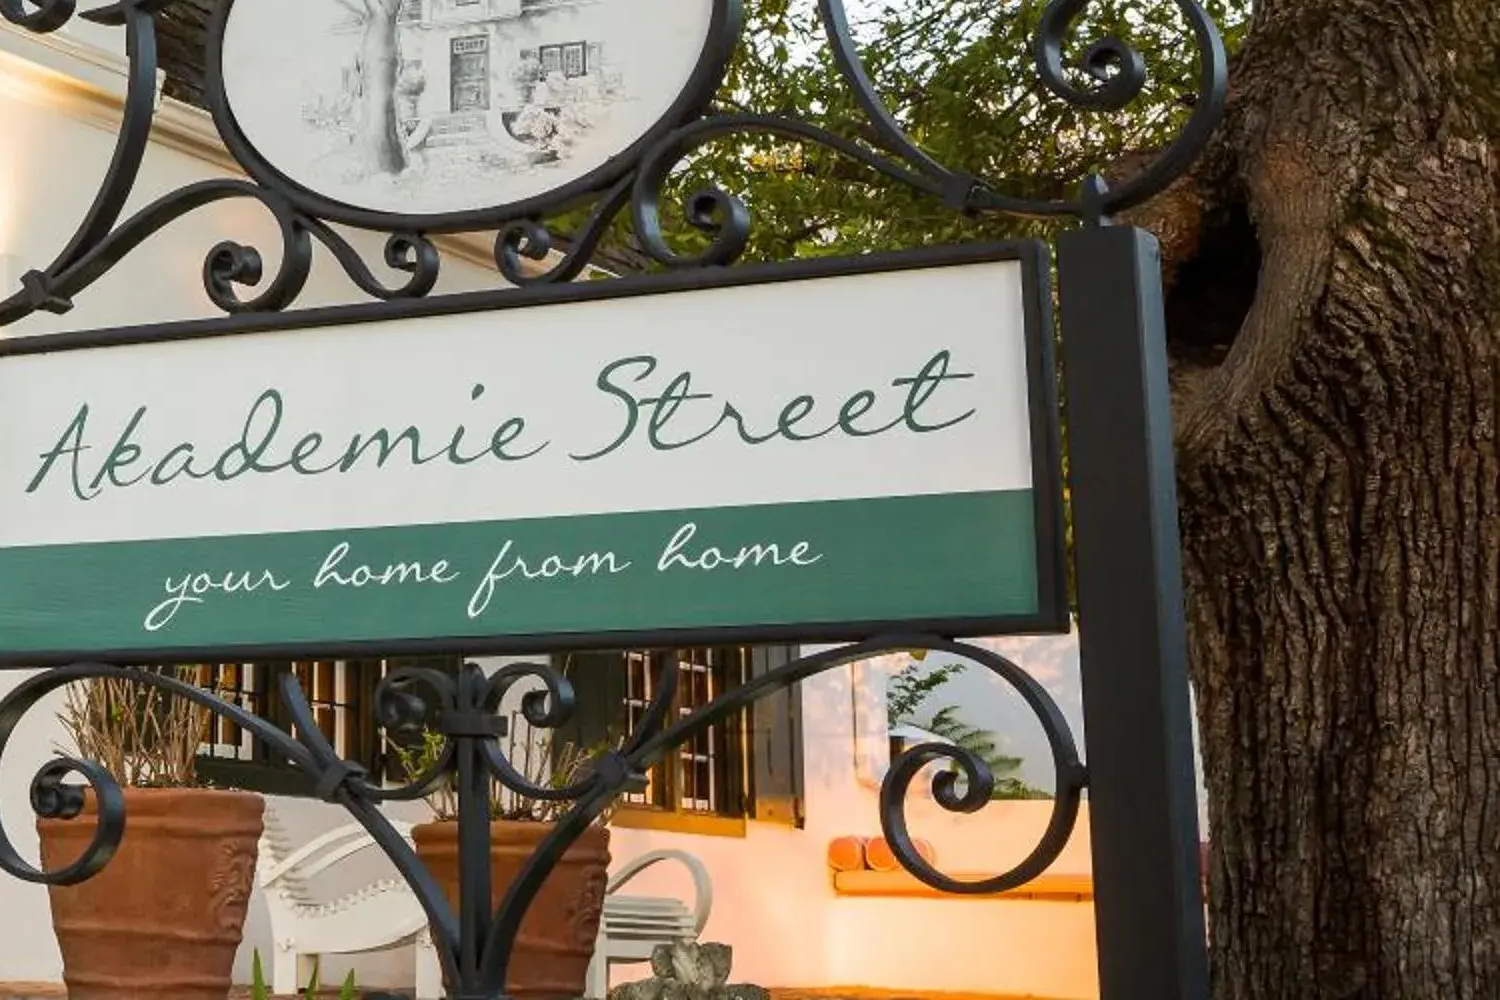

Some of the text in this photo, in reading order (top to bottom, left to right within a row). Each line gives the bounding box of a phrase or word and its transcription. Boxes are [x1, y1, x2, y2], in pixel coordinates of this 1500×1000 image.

[25, 350, 976, 501] Akademie Street
[143, 521, 824, 631] your home from home
